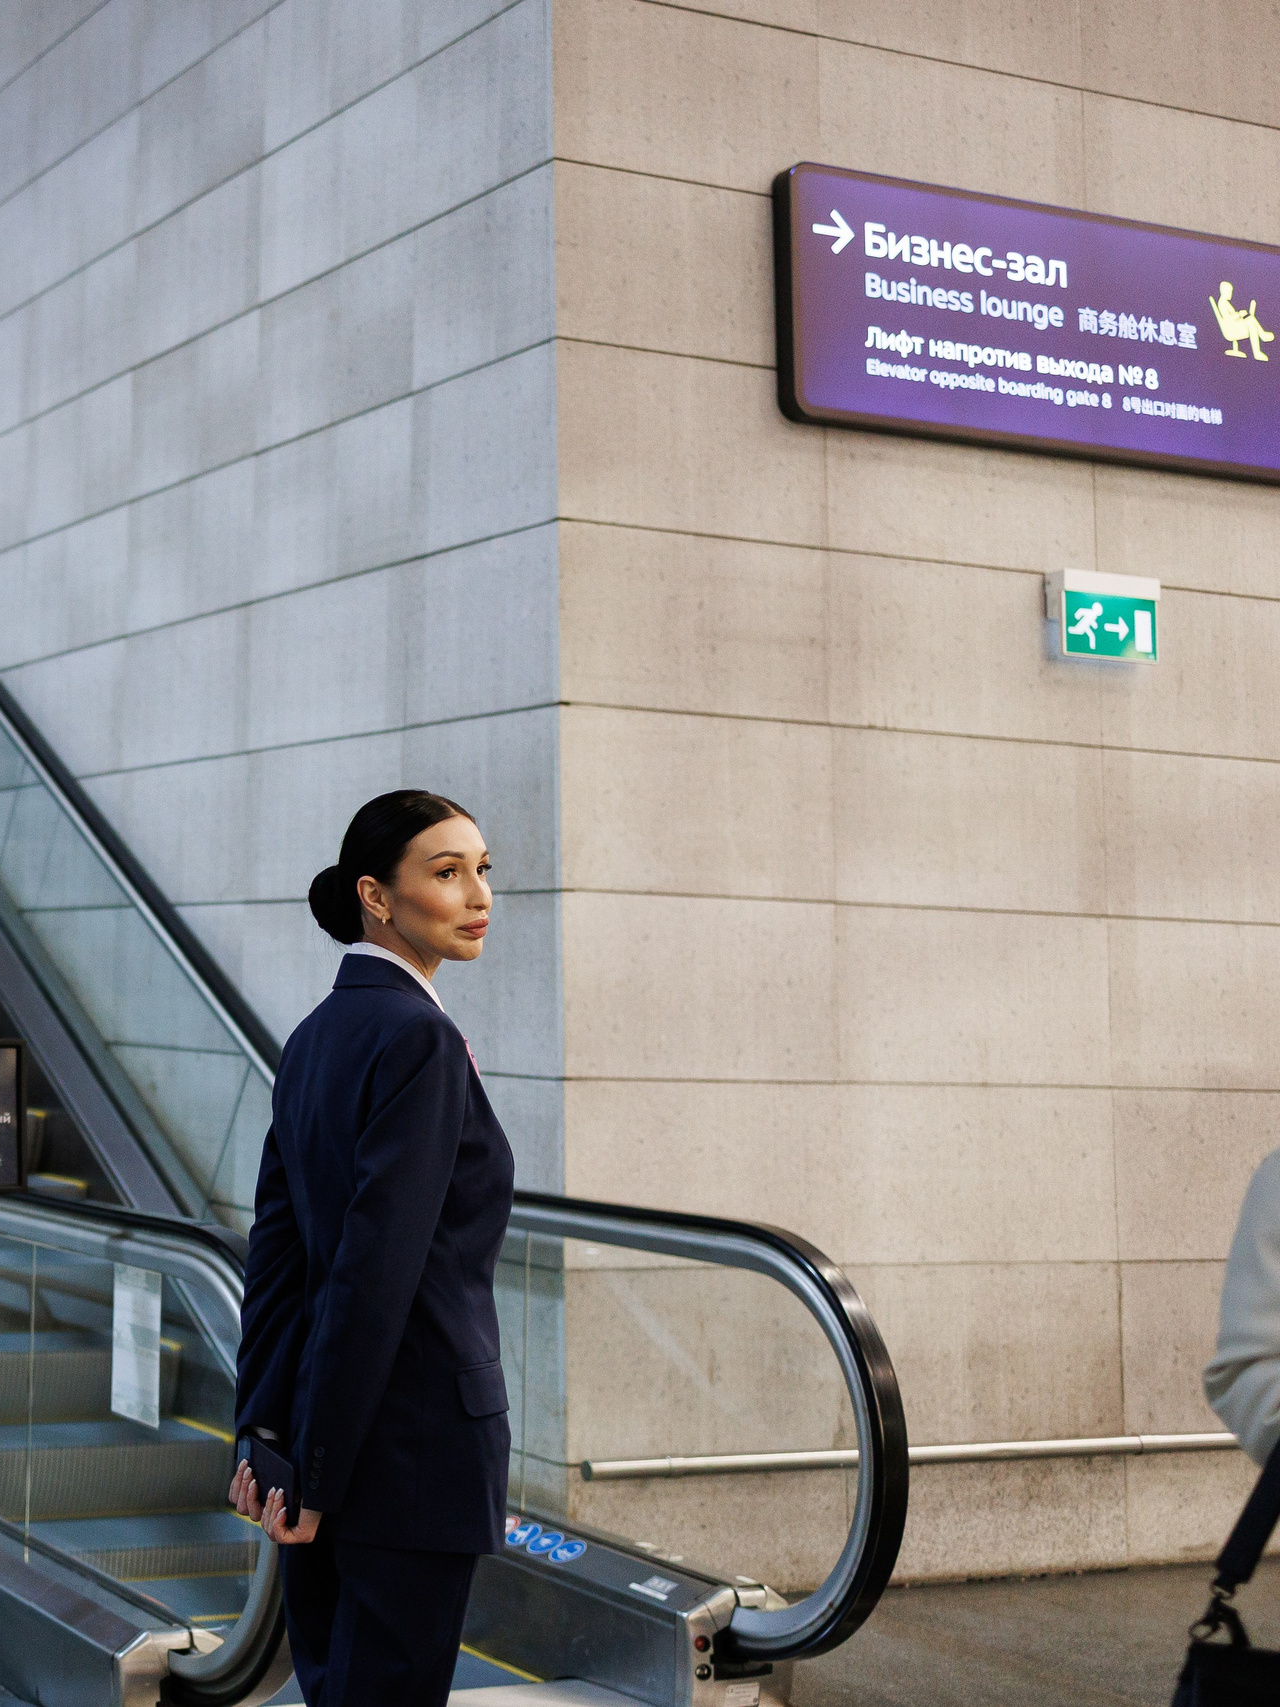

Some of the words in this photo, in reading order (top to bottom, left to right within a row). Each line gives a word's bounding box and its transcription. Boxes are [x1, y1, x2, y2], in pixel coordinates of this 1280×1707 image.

[864, 222, 1068, 288] Бизнес-зал
[865, 273, 974, 312] Business
[980, 291, 1064, 330] lounge
[1078, 307, 1198, 349] 商务舱休息室
[865, 326, 924, 357] Лифт
[929, 339, 1032, 371] напротив
[1037, 355, 1114, 384] выхода
[866, 359, 928, 382] Elevator
[930, 370, 996, 392] opposite
[998, 377, 1063, 404] boarding
[1066, 390, 1099, 407] gate
[1102, 393, 1112, 409] 8
